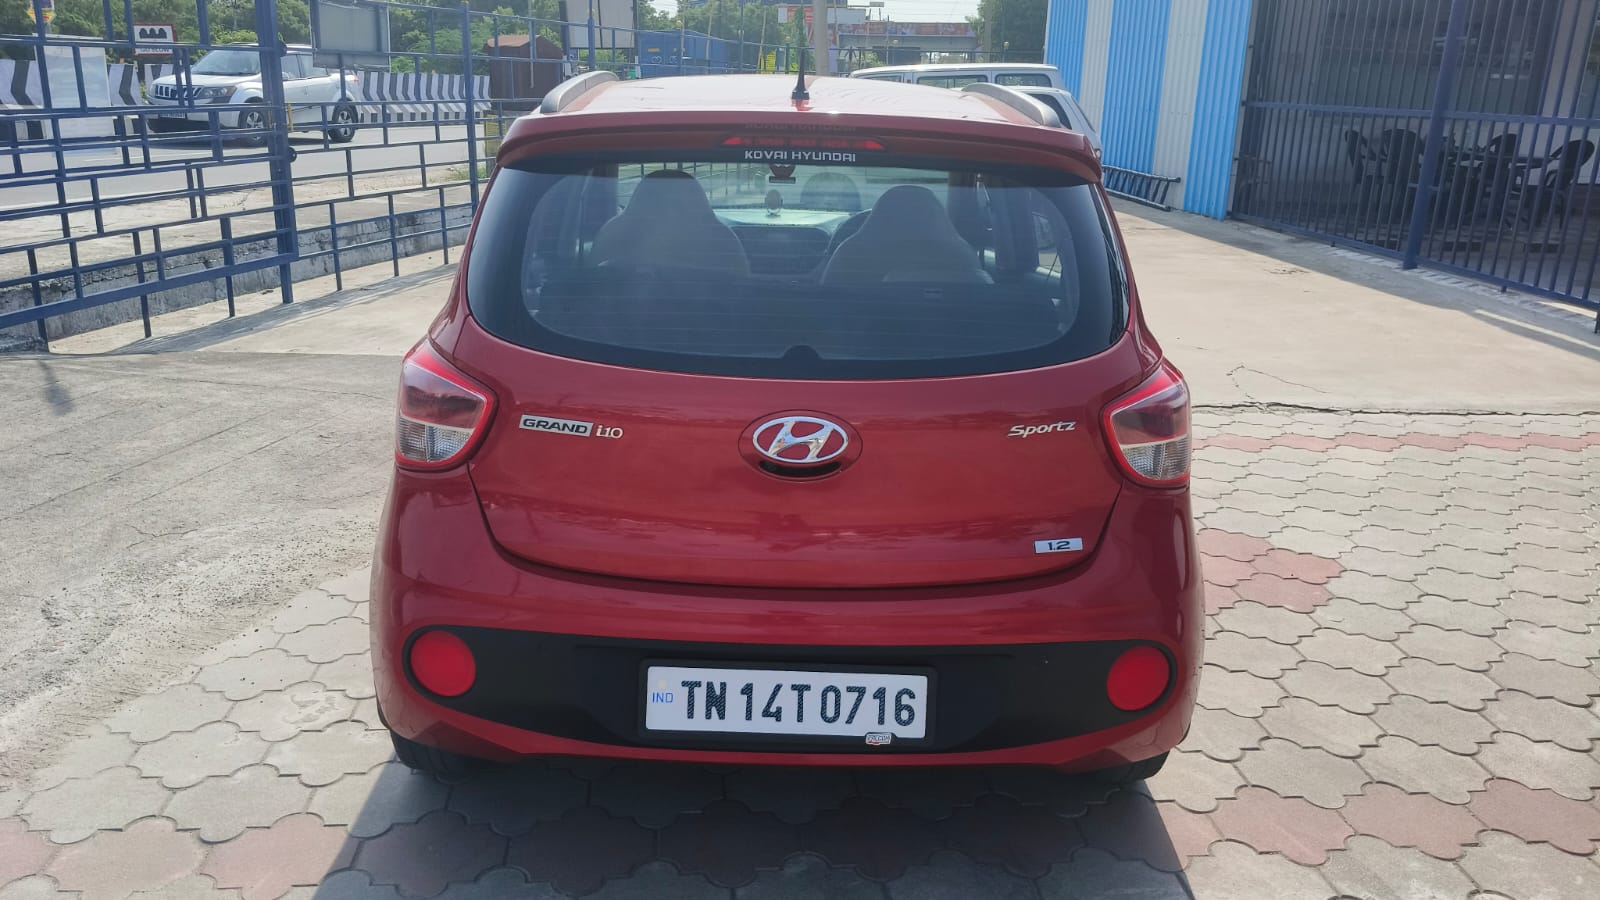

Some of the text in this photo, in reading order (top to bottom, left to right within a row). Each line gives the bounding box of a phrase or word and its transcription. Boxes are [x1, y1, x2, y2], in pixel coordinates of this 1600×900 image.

[745, 151, 856, 162] KOVAI HYUNDAI
[522, 418, 624, 439] GRAND i10
[1008, 421, 1077, 438] Sportz
[1047, 540, 1071, 551] 1.2
[652, 692, 674, 703] IND
